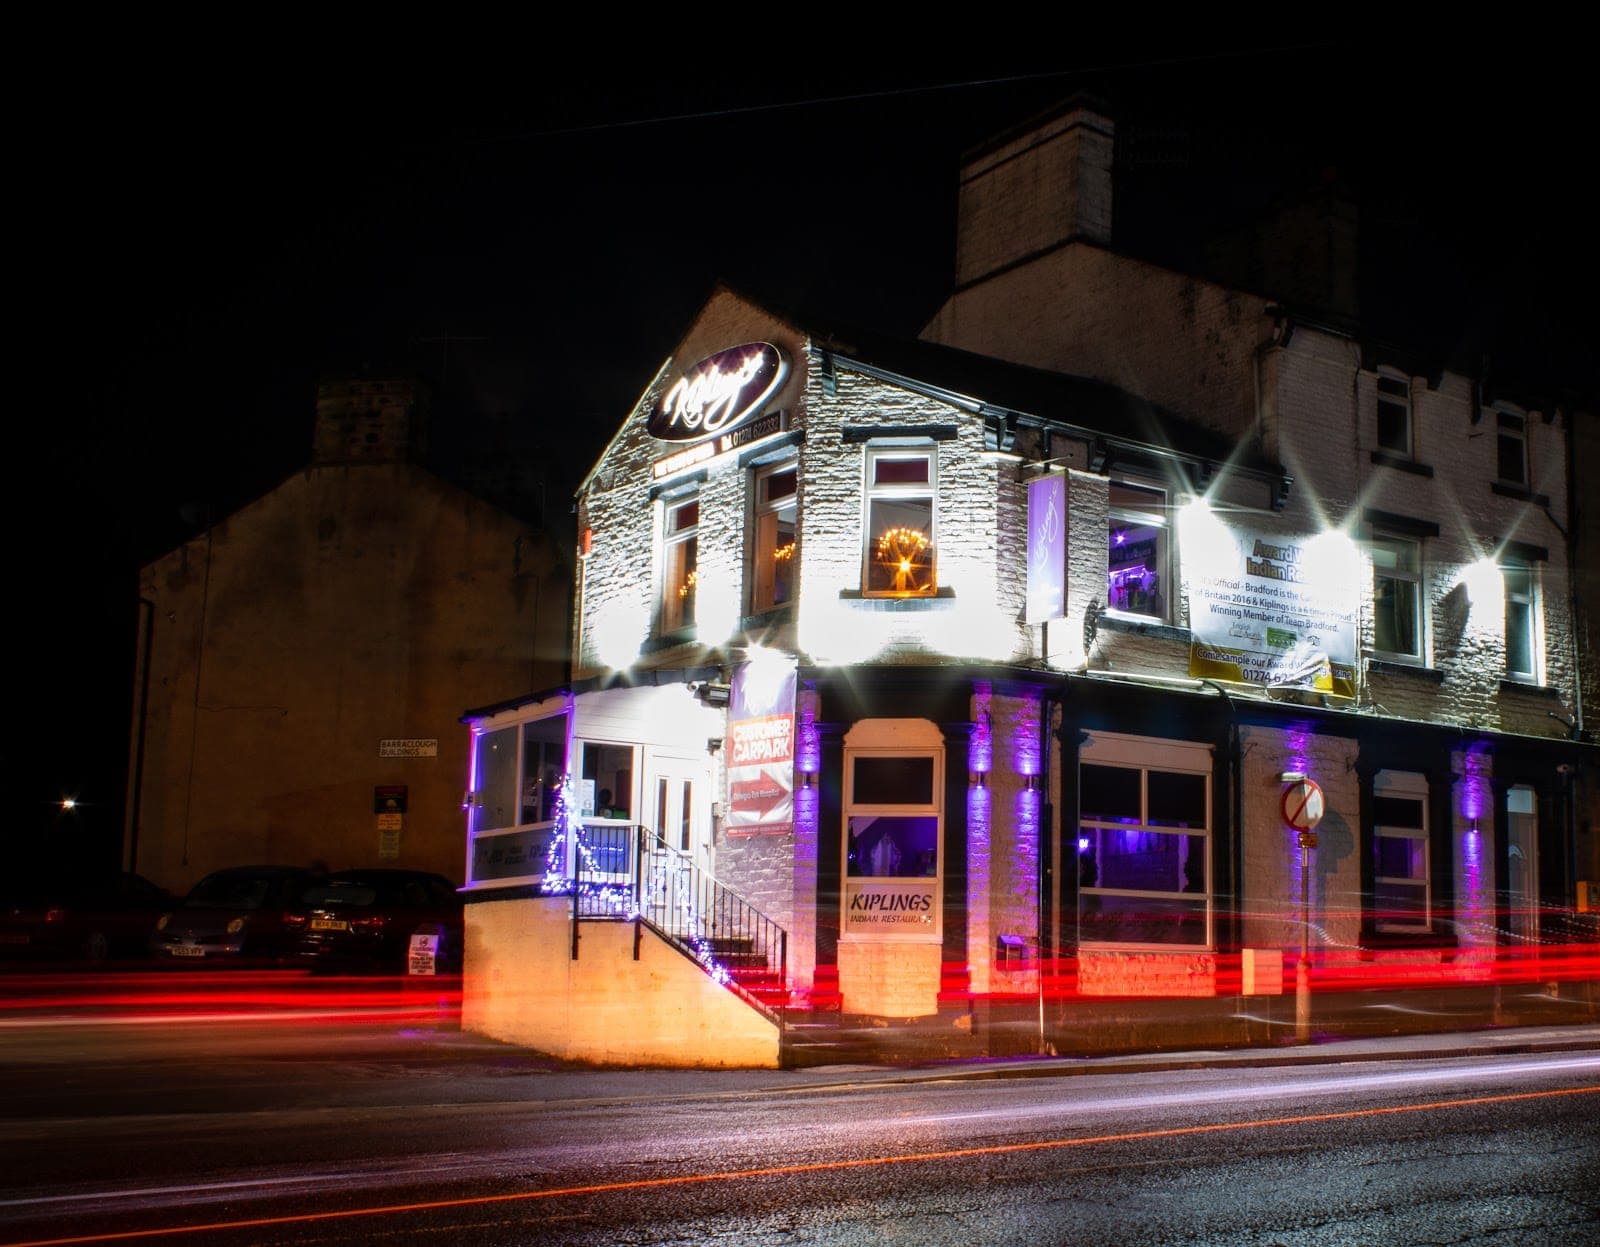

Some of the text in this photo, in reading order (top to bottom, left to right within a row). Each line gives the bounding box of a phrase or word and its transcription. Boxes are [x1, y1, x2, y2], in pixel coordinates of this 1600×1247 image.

[1253, 539, 1294, 563] Award
[1246, 556, 1287, 581] Indian
[1213, 577, 1240, 590] Official
[1245, 582, 1278, 597] Bradford
[1279, 588, 1286, 598] is
[1287, 589, 1299, 601] the
[1204, 590, 1231, 601] Britain
[1232, 594, 1251, 605] 2016
[1259, 598, 1289, 613] Kiplings
[1209, 603, 1242, 620] Winning
[1243, 608, 1276, 623] Member
[1285, 616, 1305, 628] Team
[1197, 648, 1221, 660] Come
[1221, 653, 1250, 665] sample
[1251, 659, 1265, 667] our
[1266, 658, 1294, 670] Award
[1243, 668, 1271, 683] 01274
[850, 894, 932, 911] KIPLINGS
[850, 914, 932, 924] INDIAN RESTAURAT
